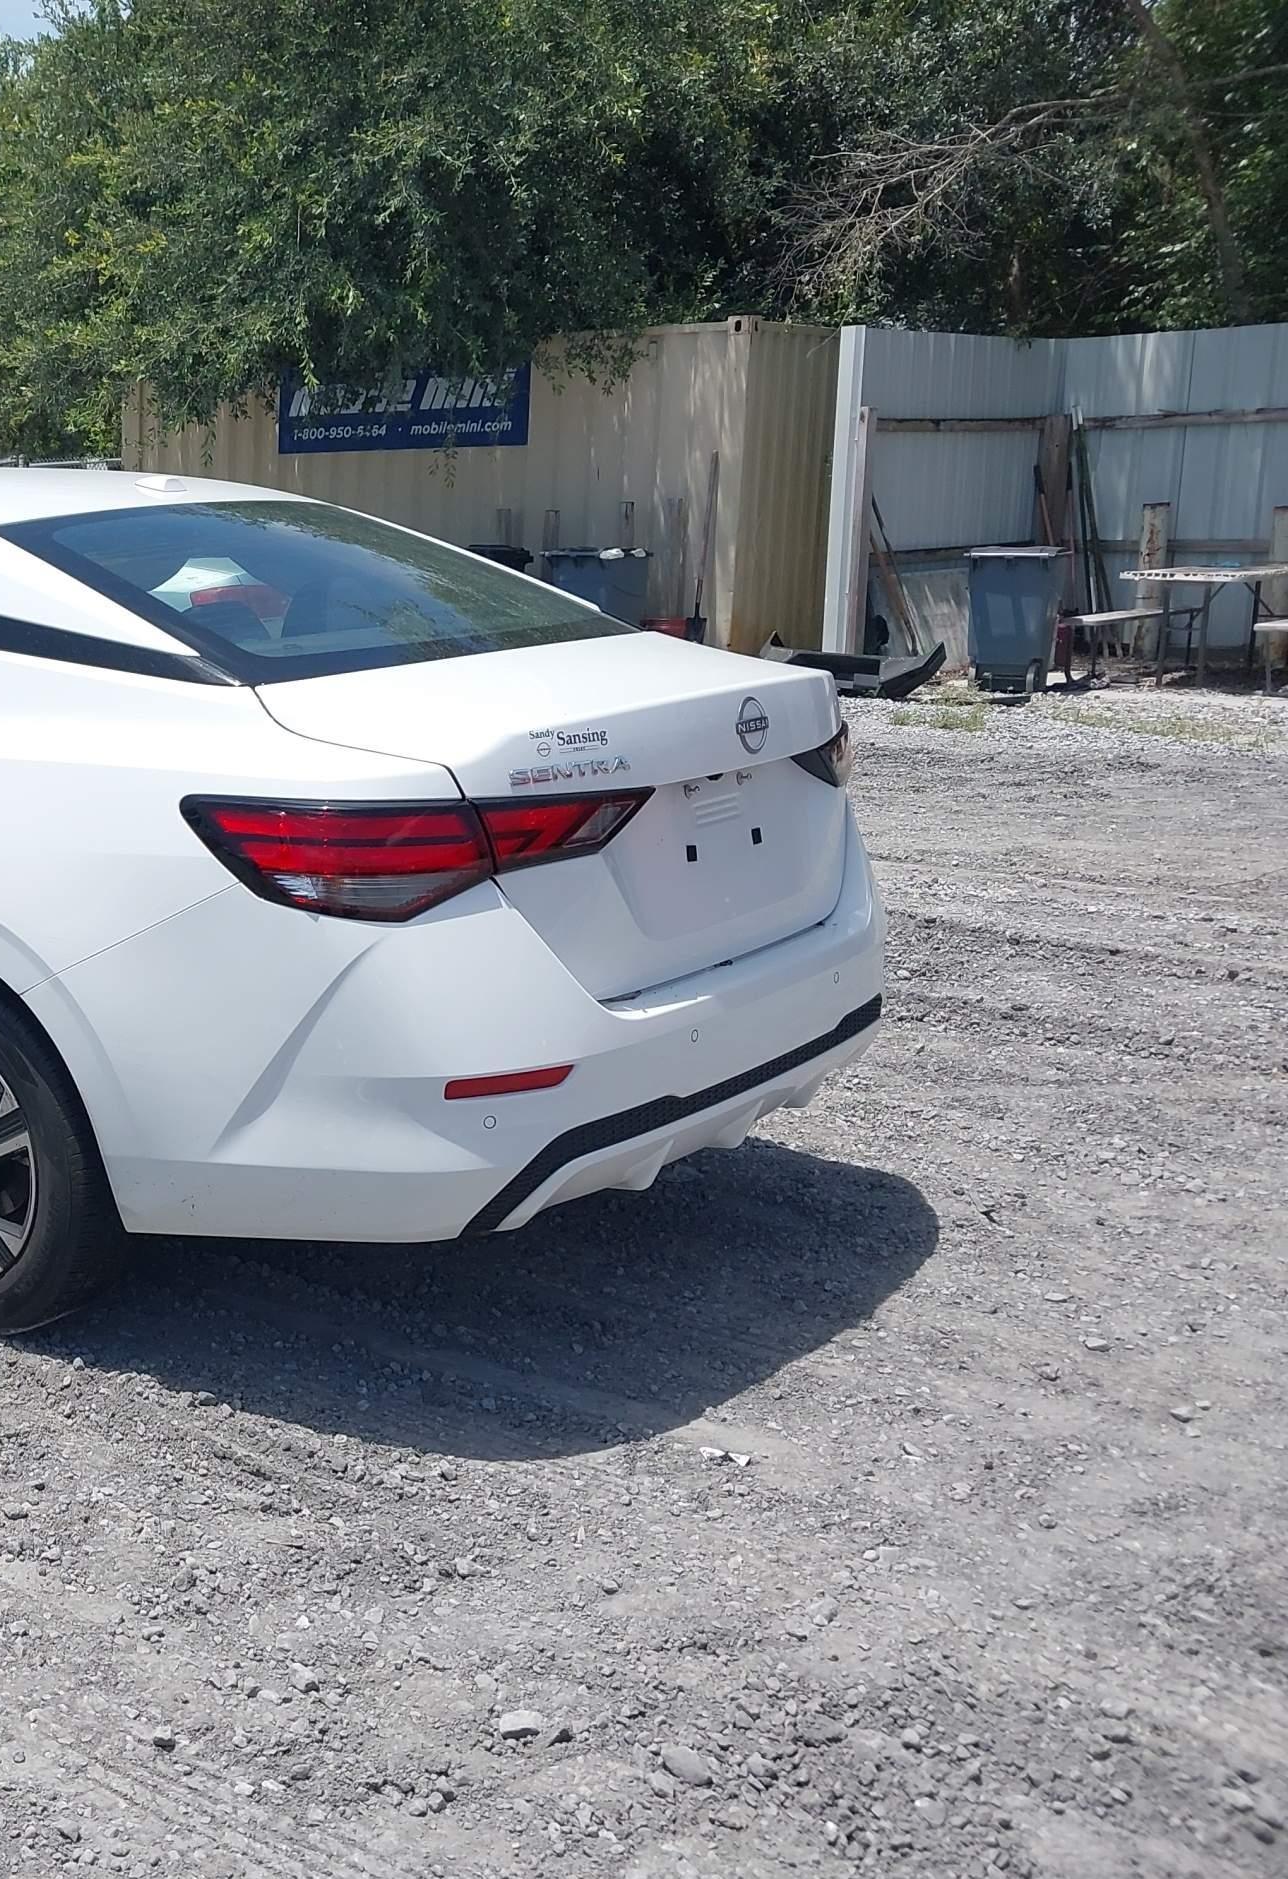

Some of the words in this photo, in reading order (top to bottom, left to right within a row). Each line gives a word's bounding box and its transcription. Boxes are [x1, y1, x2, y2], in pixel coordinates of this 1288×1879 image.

[529, 728, 555, 740] Sandy
[557, 727, 609, 747] Sansing
[509, 755, 631, 786] SENTRA
